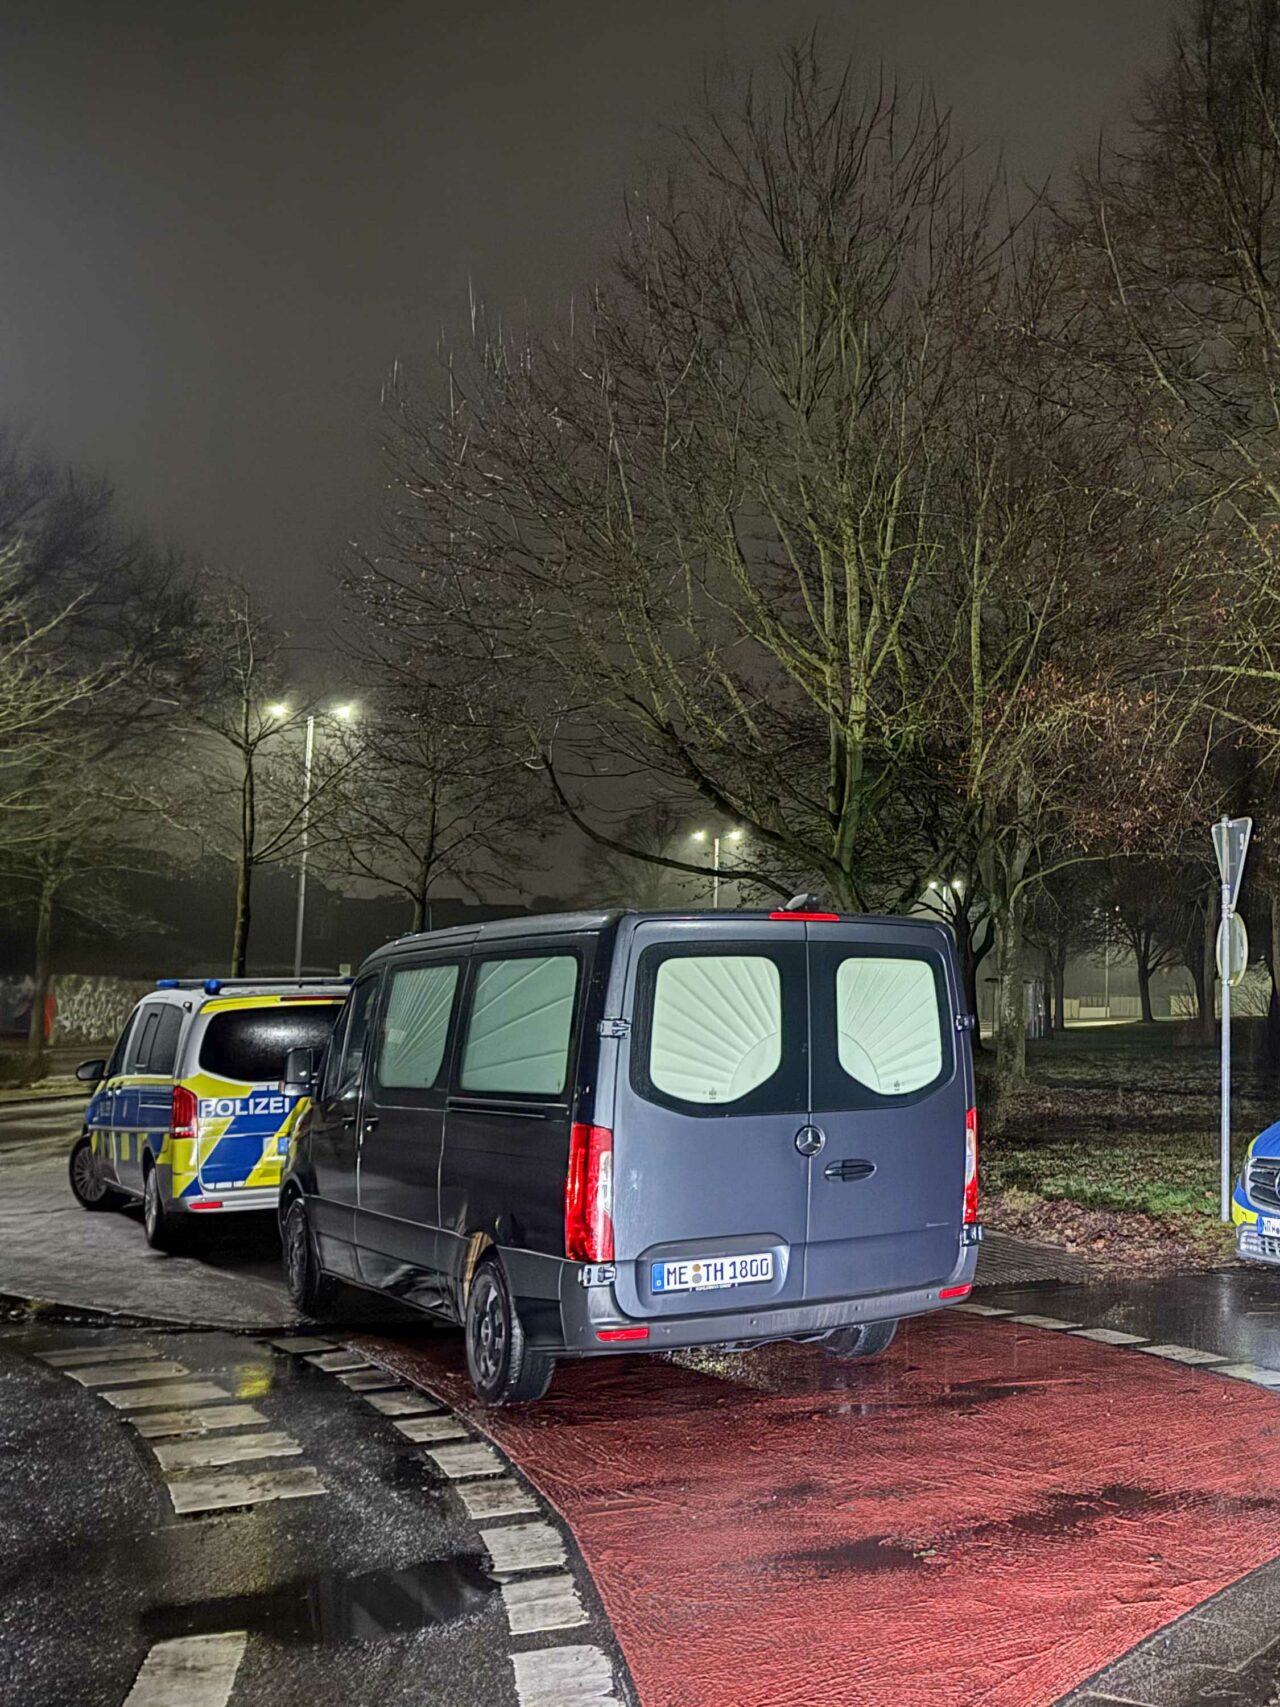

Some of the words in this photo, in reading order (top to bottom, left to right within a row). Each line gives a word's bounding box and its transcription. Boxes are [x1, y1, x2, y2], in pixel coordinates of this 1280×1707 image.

[200, 1096, 290, 1118] POLIZEI
[666, 1265, 689, 1286] ME
[702, 1262, 724, 1282] TH
[729, 1258, 769, 1280] 1800
